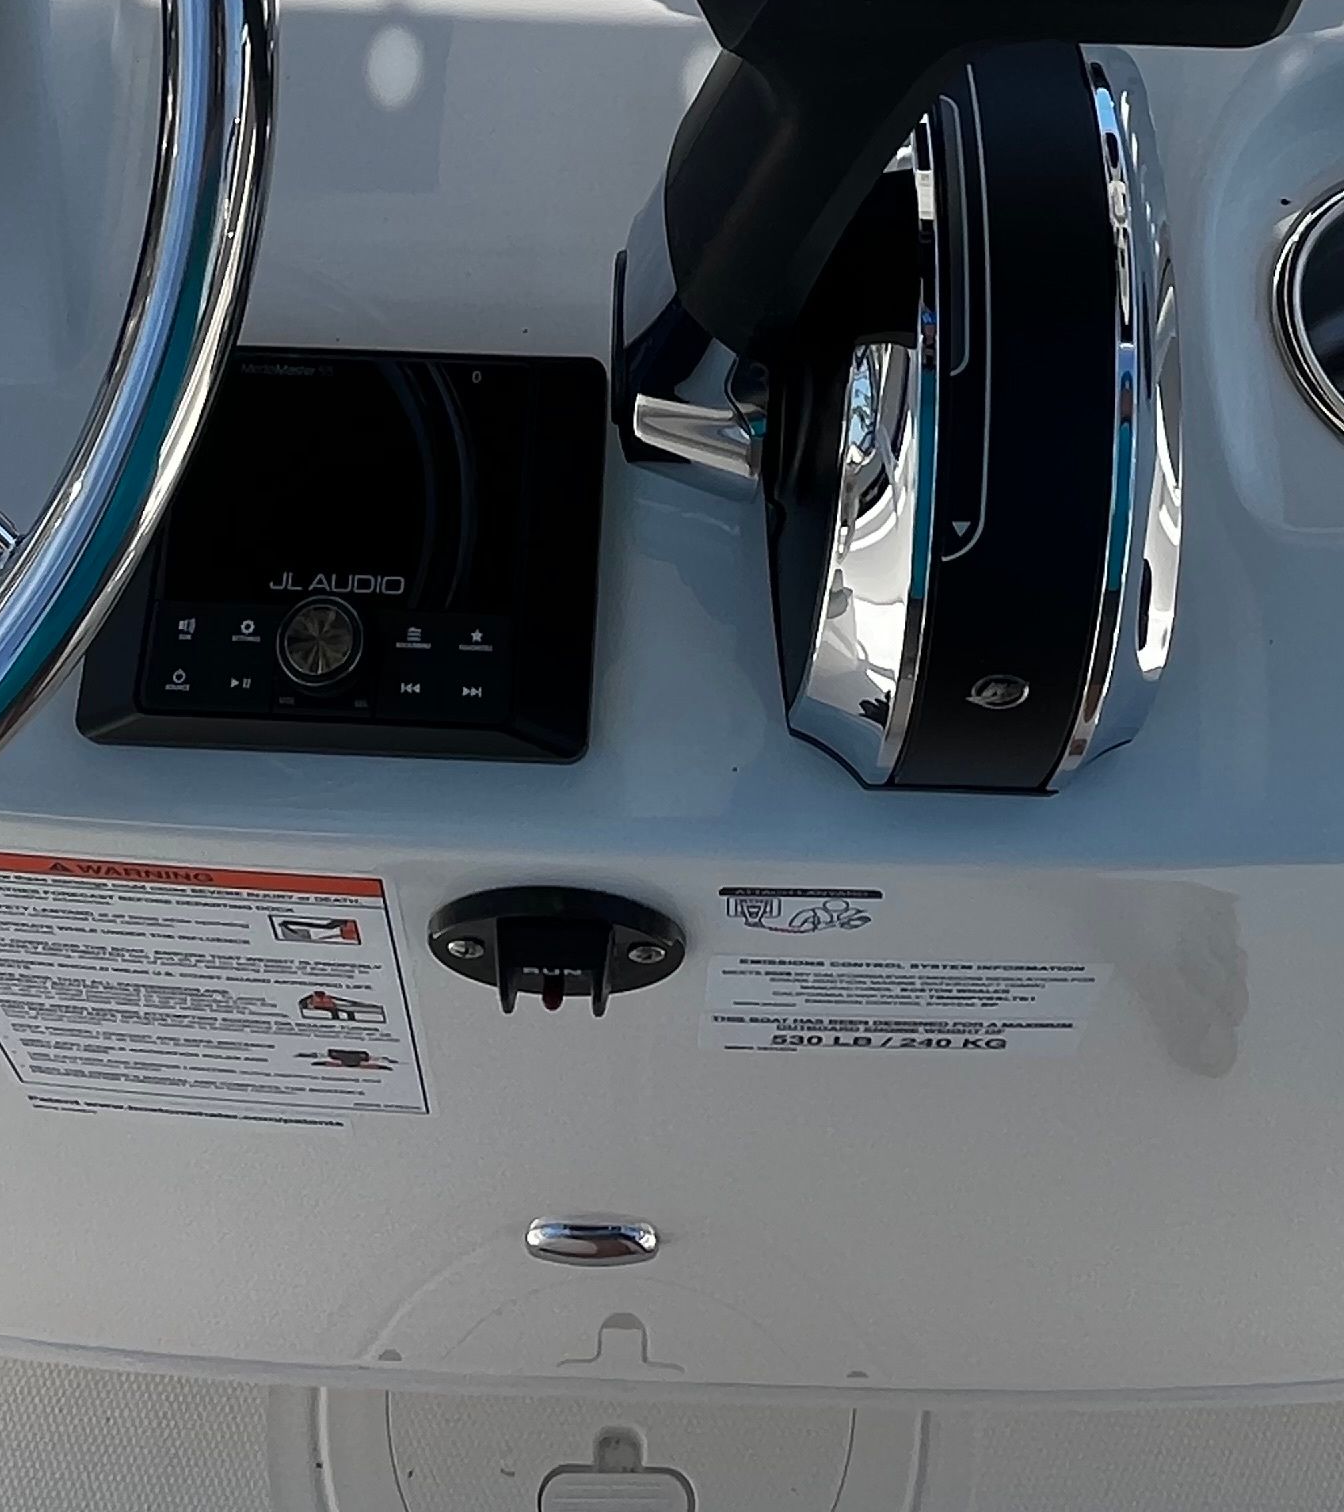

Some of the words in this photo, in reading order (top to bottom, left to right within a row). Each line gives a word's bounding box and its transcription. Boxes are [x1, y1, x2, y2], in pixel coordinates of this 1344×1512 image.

[269, 572, 304, 591] JL
[308, 574, 405, 595] AUDIO
[76, 863, 214, 884] WARNING
[976, 964, 1086, 972] INFORMATION
[772, 1034, 824, 1046] 530
[899, 1037, 953, 1049] 240
[962, 1038, 1007, 1049] KG
